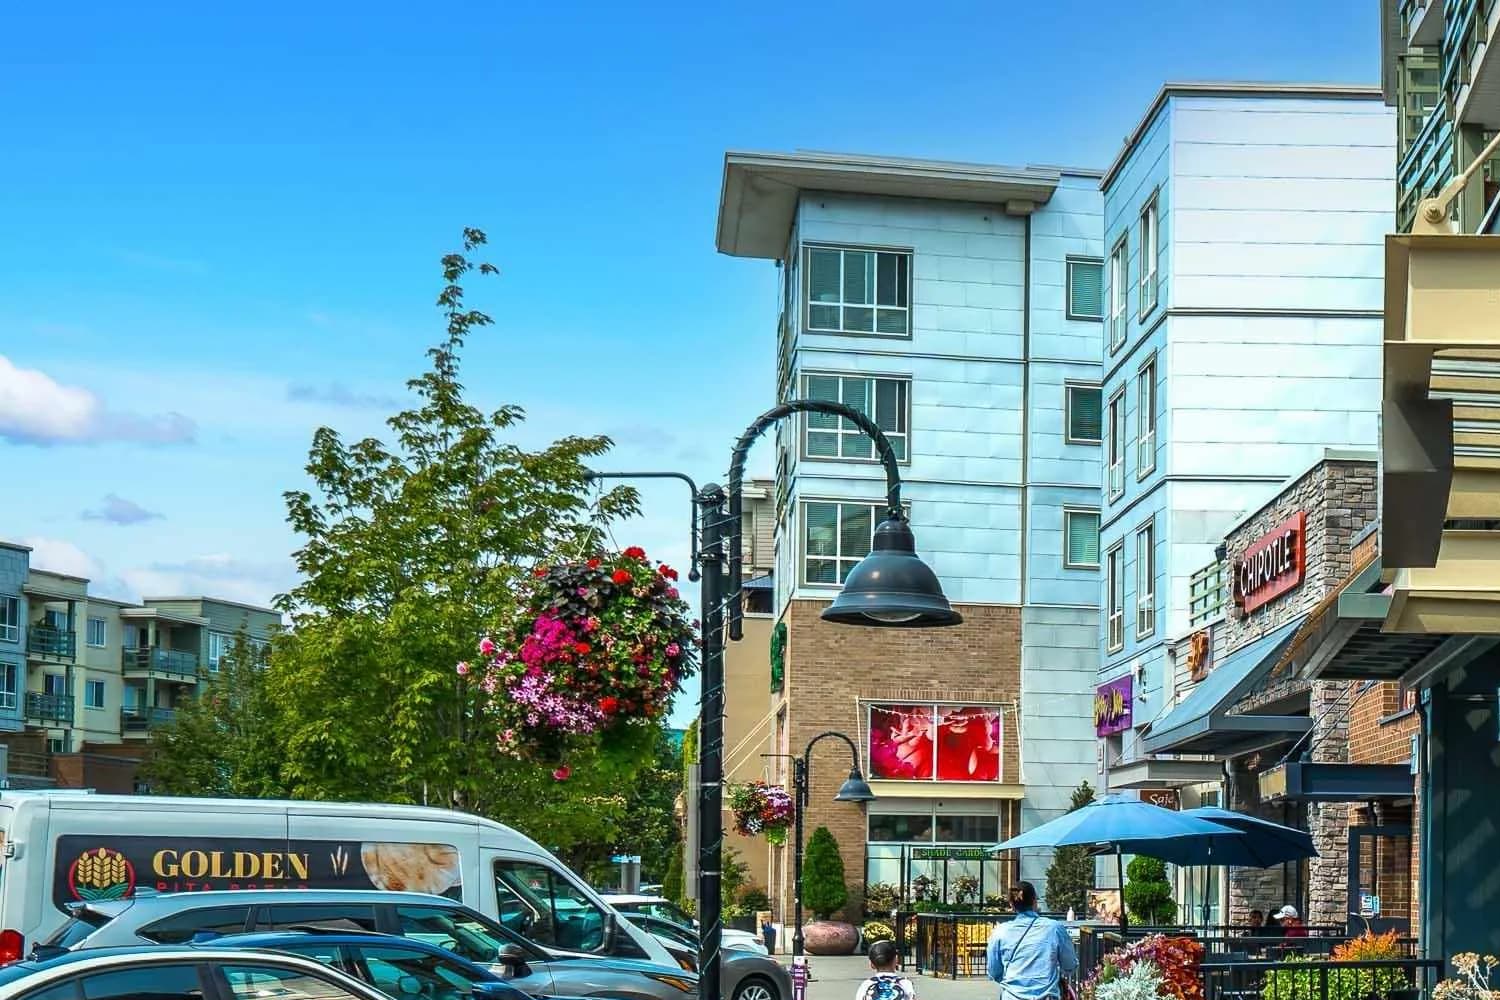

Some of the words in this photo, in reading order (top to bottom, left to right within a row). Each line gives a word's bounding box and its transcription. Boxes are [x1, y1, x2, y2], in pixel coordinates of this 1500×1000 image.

[1240, 530, 1291, 597] CHIPOTLE
[1149, 793, 1174, 808] Saje
[152, 849, 310, 881] GOLDEN
